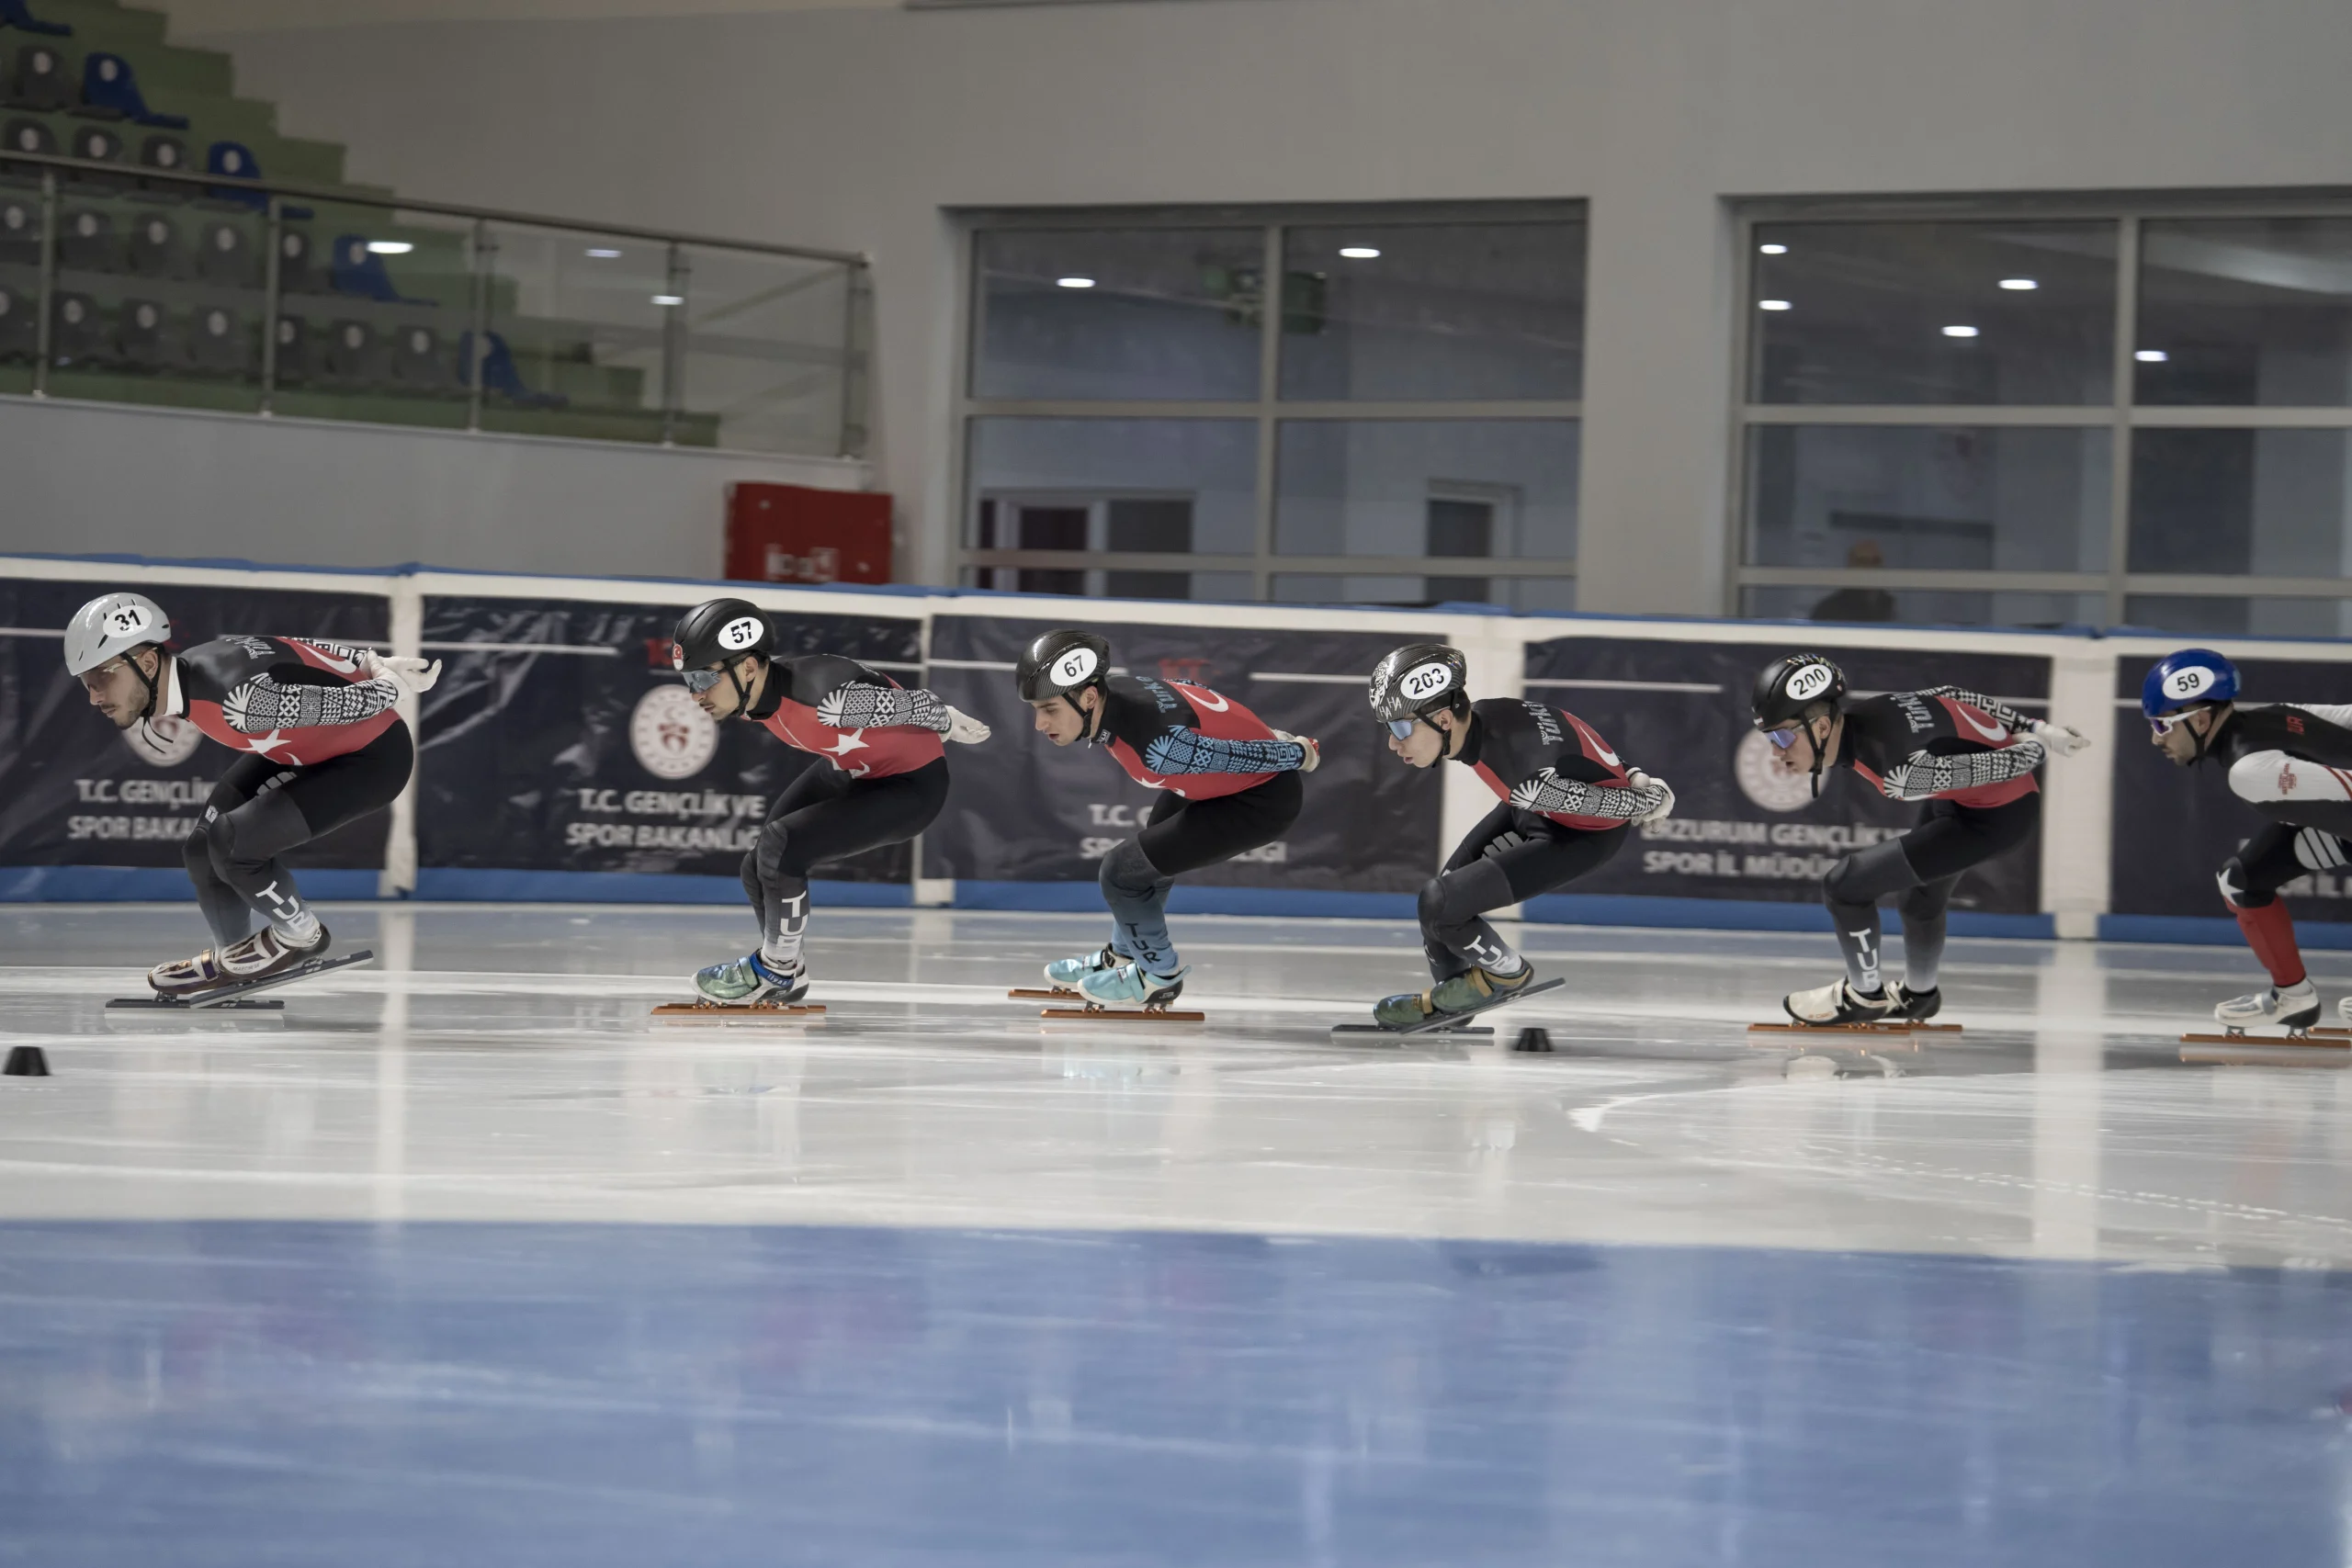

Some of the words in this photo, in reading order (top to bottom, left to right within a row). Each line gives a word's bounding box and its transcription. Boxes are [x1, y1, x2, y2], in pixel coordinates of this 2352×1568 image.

[114, 609, 141, 631] 31
[730, 621, 752, 644] 57
[1064, 655, 1084, 678] 67
[1409, 668, 1444, 695] 203
[1793, 669, 1826, 696] 200
[2177, 672, 2200, 693] 59
[730, 794, 766, 818] VE
[565, 822, 634, 846] SPOR
[1643, 851, 1713, 874] SPOR
[255, 880, 309, 932] TUR
[1125, 923, 1161, 964] TUR
[1849, 928, 1880, 988] TUR
